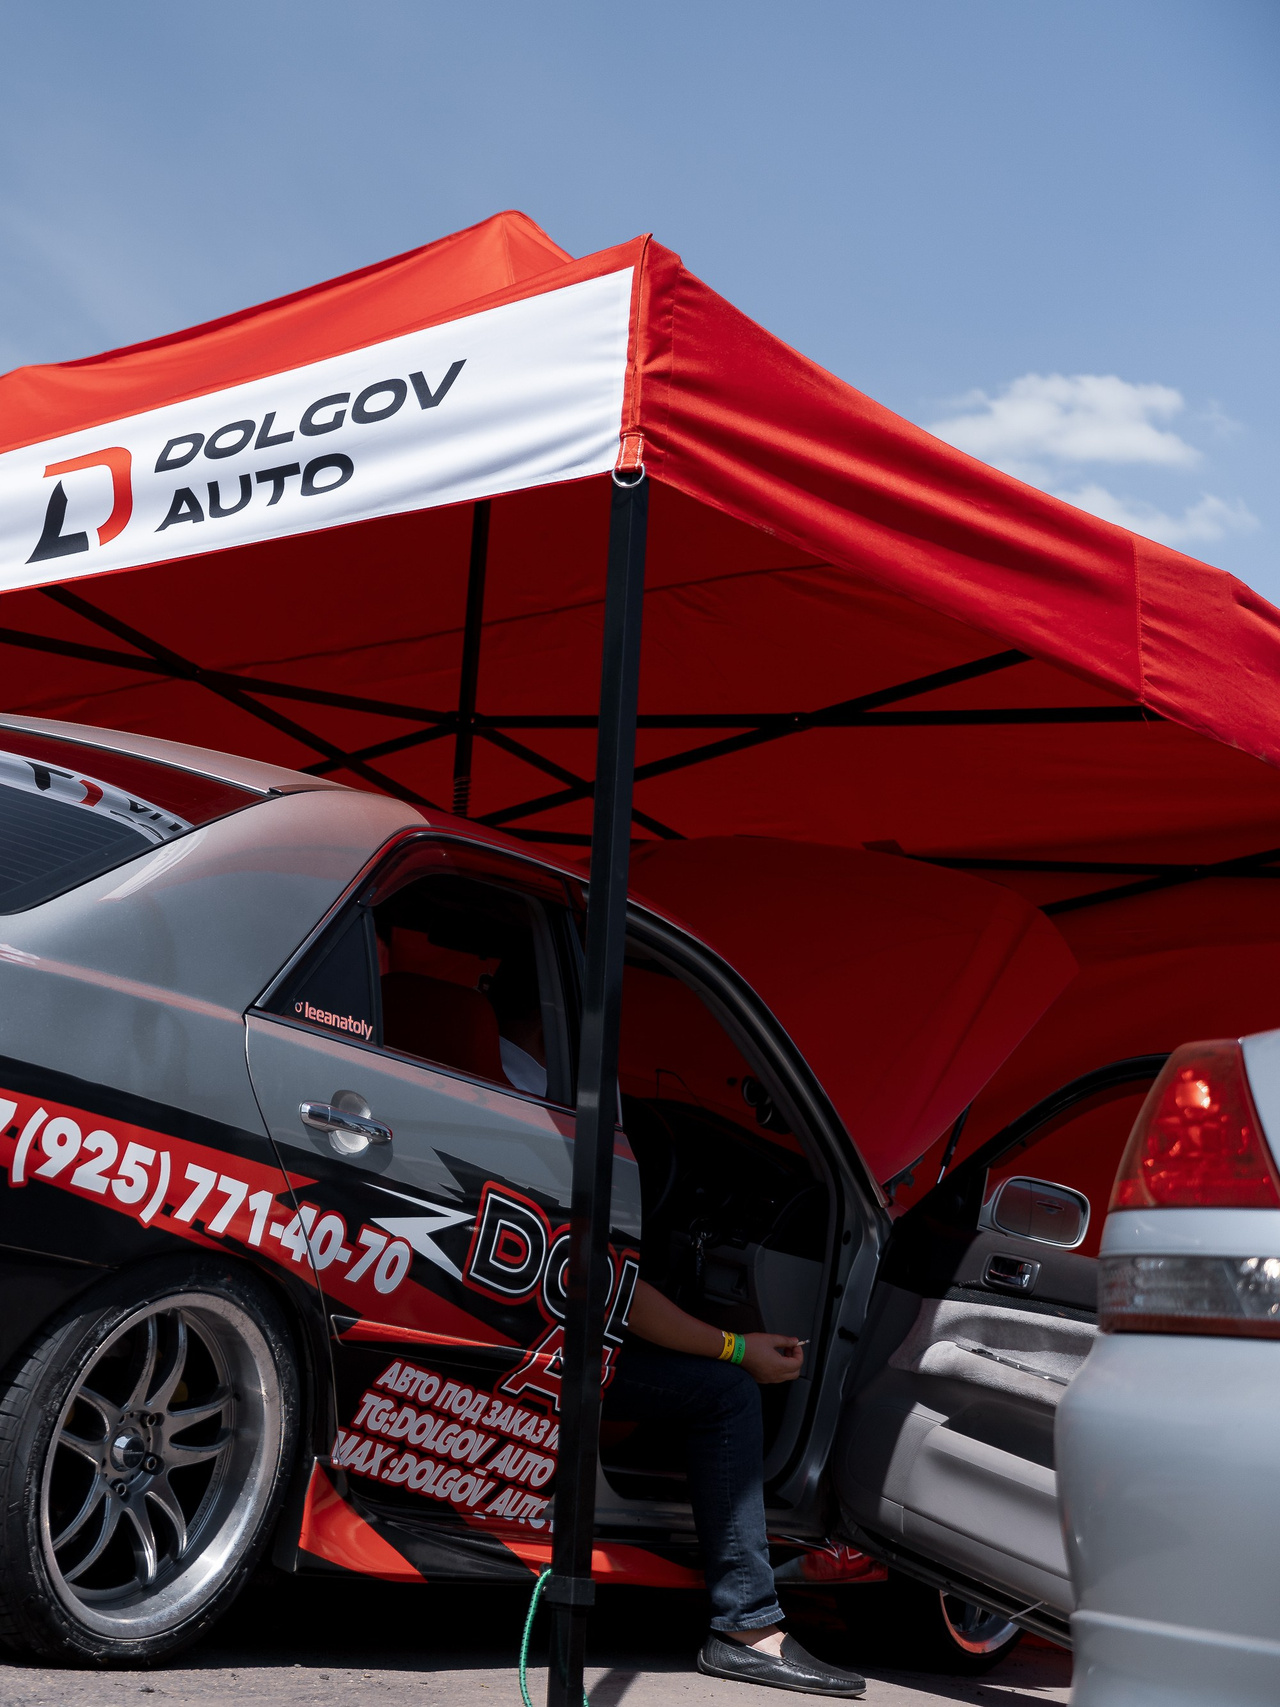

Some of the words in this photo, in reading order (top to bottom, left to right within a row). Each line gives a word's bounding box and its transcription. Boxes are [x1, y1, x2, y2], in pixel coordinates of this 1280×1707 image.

[154, 359, 467, 473] DOLGOV
[154, 453, 354, 532] AUTO
[304, 1002, 373, 1040] leeanatoly
[376, 1361, 439, 1401] АВТО
[434, 1381, 490, 1424] ПОД
[482, 1400, 550, 1444] ЗАКАЗ
